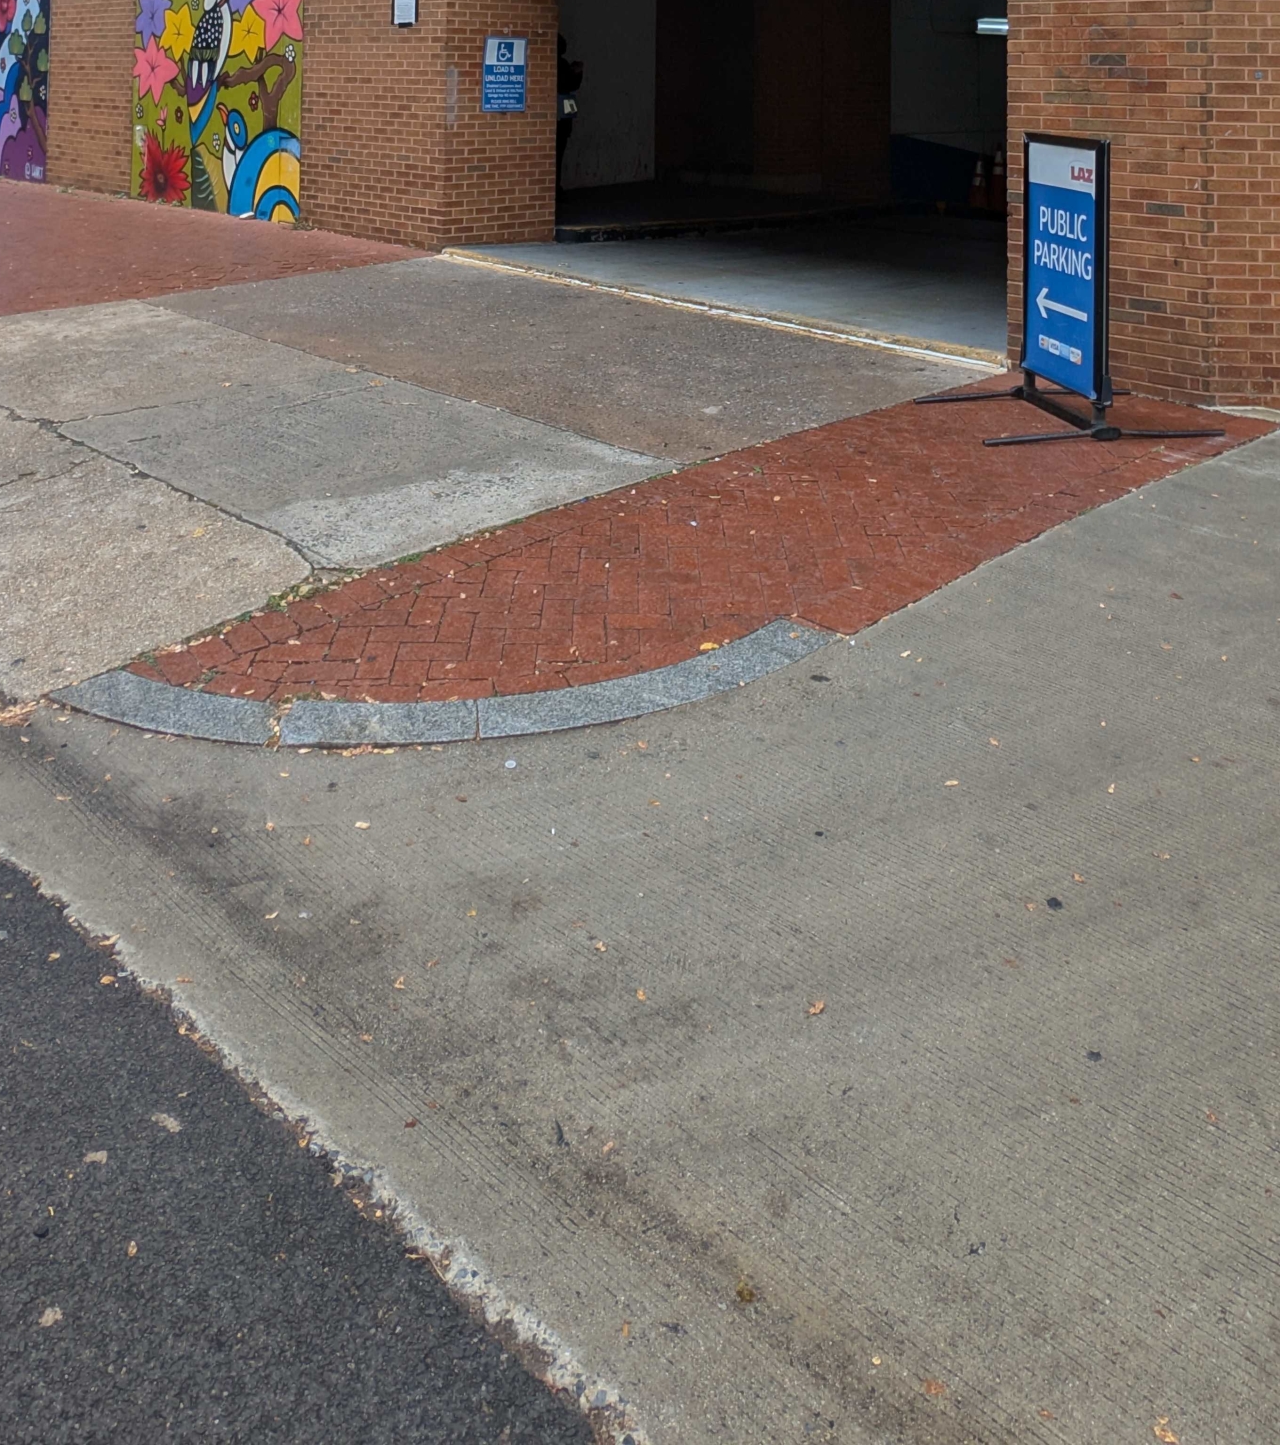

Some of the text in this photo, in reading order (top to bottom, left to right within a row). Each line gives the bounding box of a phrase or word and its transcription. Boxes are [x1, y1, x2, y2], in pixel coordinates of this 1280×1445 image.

[493, 65, 509, 73] LOAD
[1070, 165, 1093, 184] LAZ
[1039, 205, 1087, 242] PUBLIC
[1034, 239, 1092, 281] PARKING
